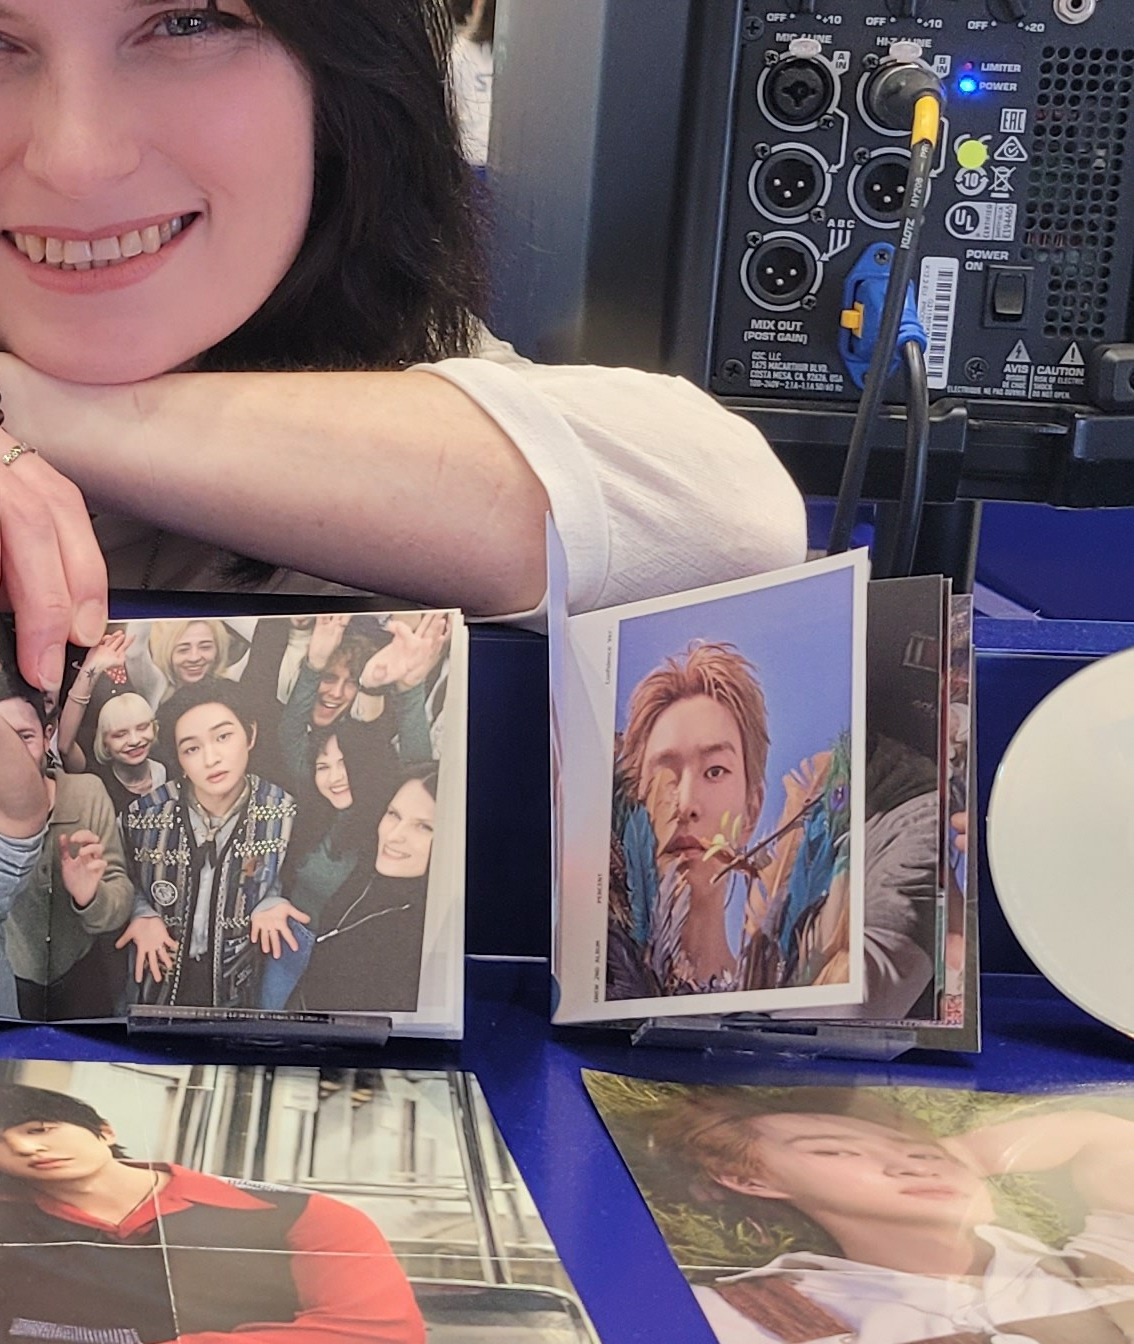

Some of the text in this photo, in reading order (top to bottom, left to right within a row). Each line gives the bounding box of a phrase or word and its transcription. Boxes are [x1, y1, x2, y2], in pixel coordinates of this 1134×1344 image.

[766, 14, 787, 22] OFF
[823, 16, 842, 25] +10
[866, 17, 886, 26] OFF
[923, 19, 943, 28] +10
[968, 21, 988, 30] OFF
[1024, 23, 1045, 32] +20
[836, 61, 846, 69] IN
[936, 65, 947, 74] IN
[981, 63, 1021, 72] LIMITER
[979, 82, 1017, 91] POWER
[964, 174, 978, 187] 10
[955, 210, 974, 231] UL
[900, 217, 915, 249] KLOTZ
[966, 250, 1009, 260] POWER
[965, 261, 983, 271] ON
[751, 319, 803, 331] MIX OUT
[744, 331, 808, 344] (POST GAIN)
[1003, 363, 1028, 373] AVIS
[1037, 365, 1084, 376] CAUTION
